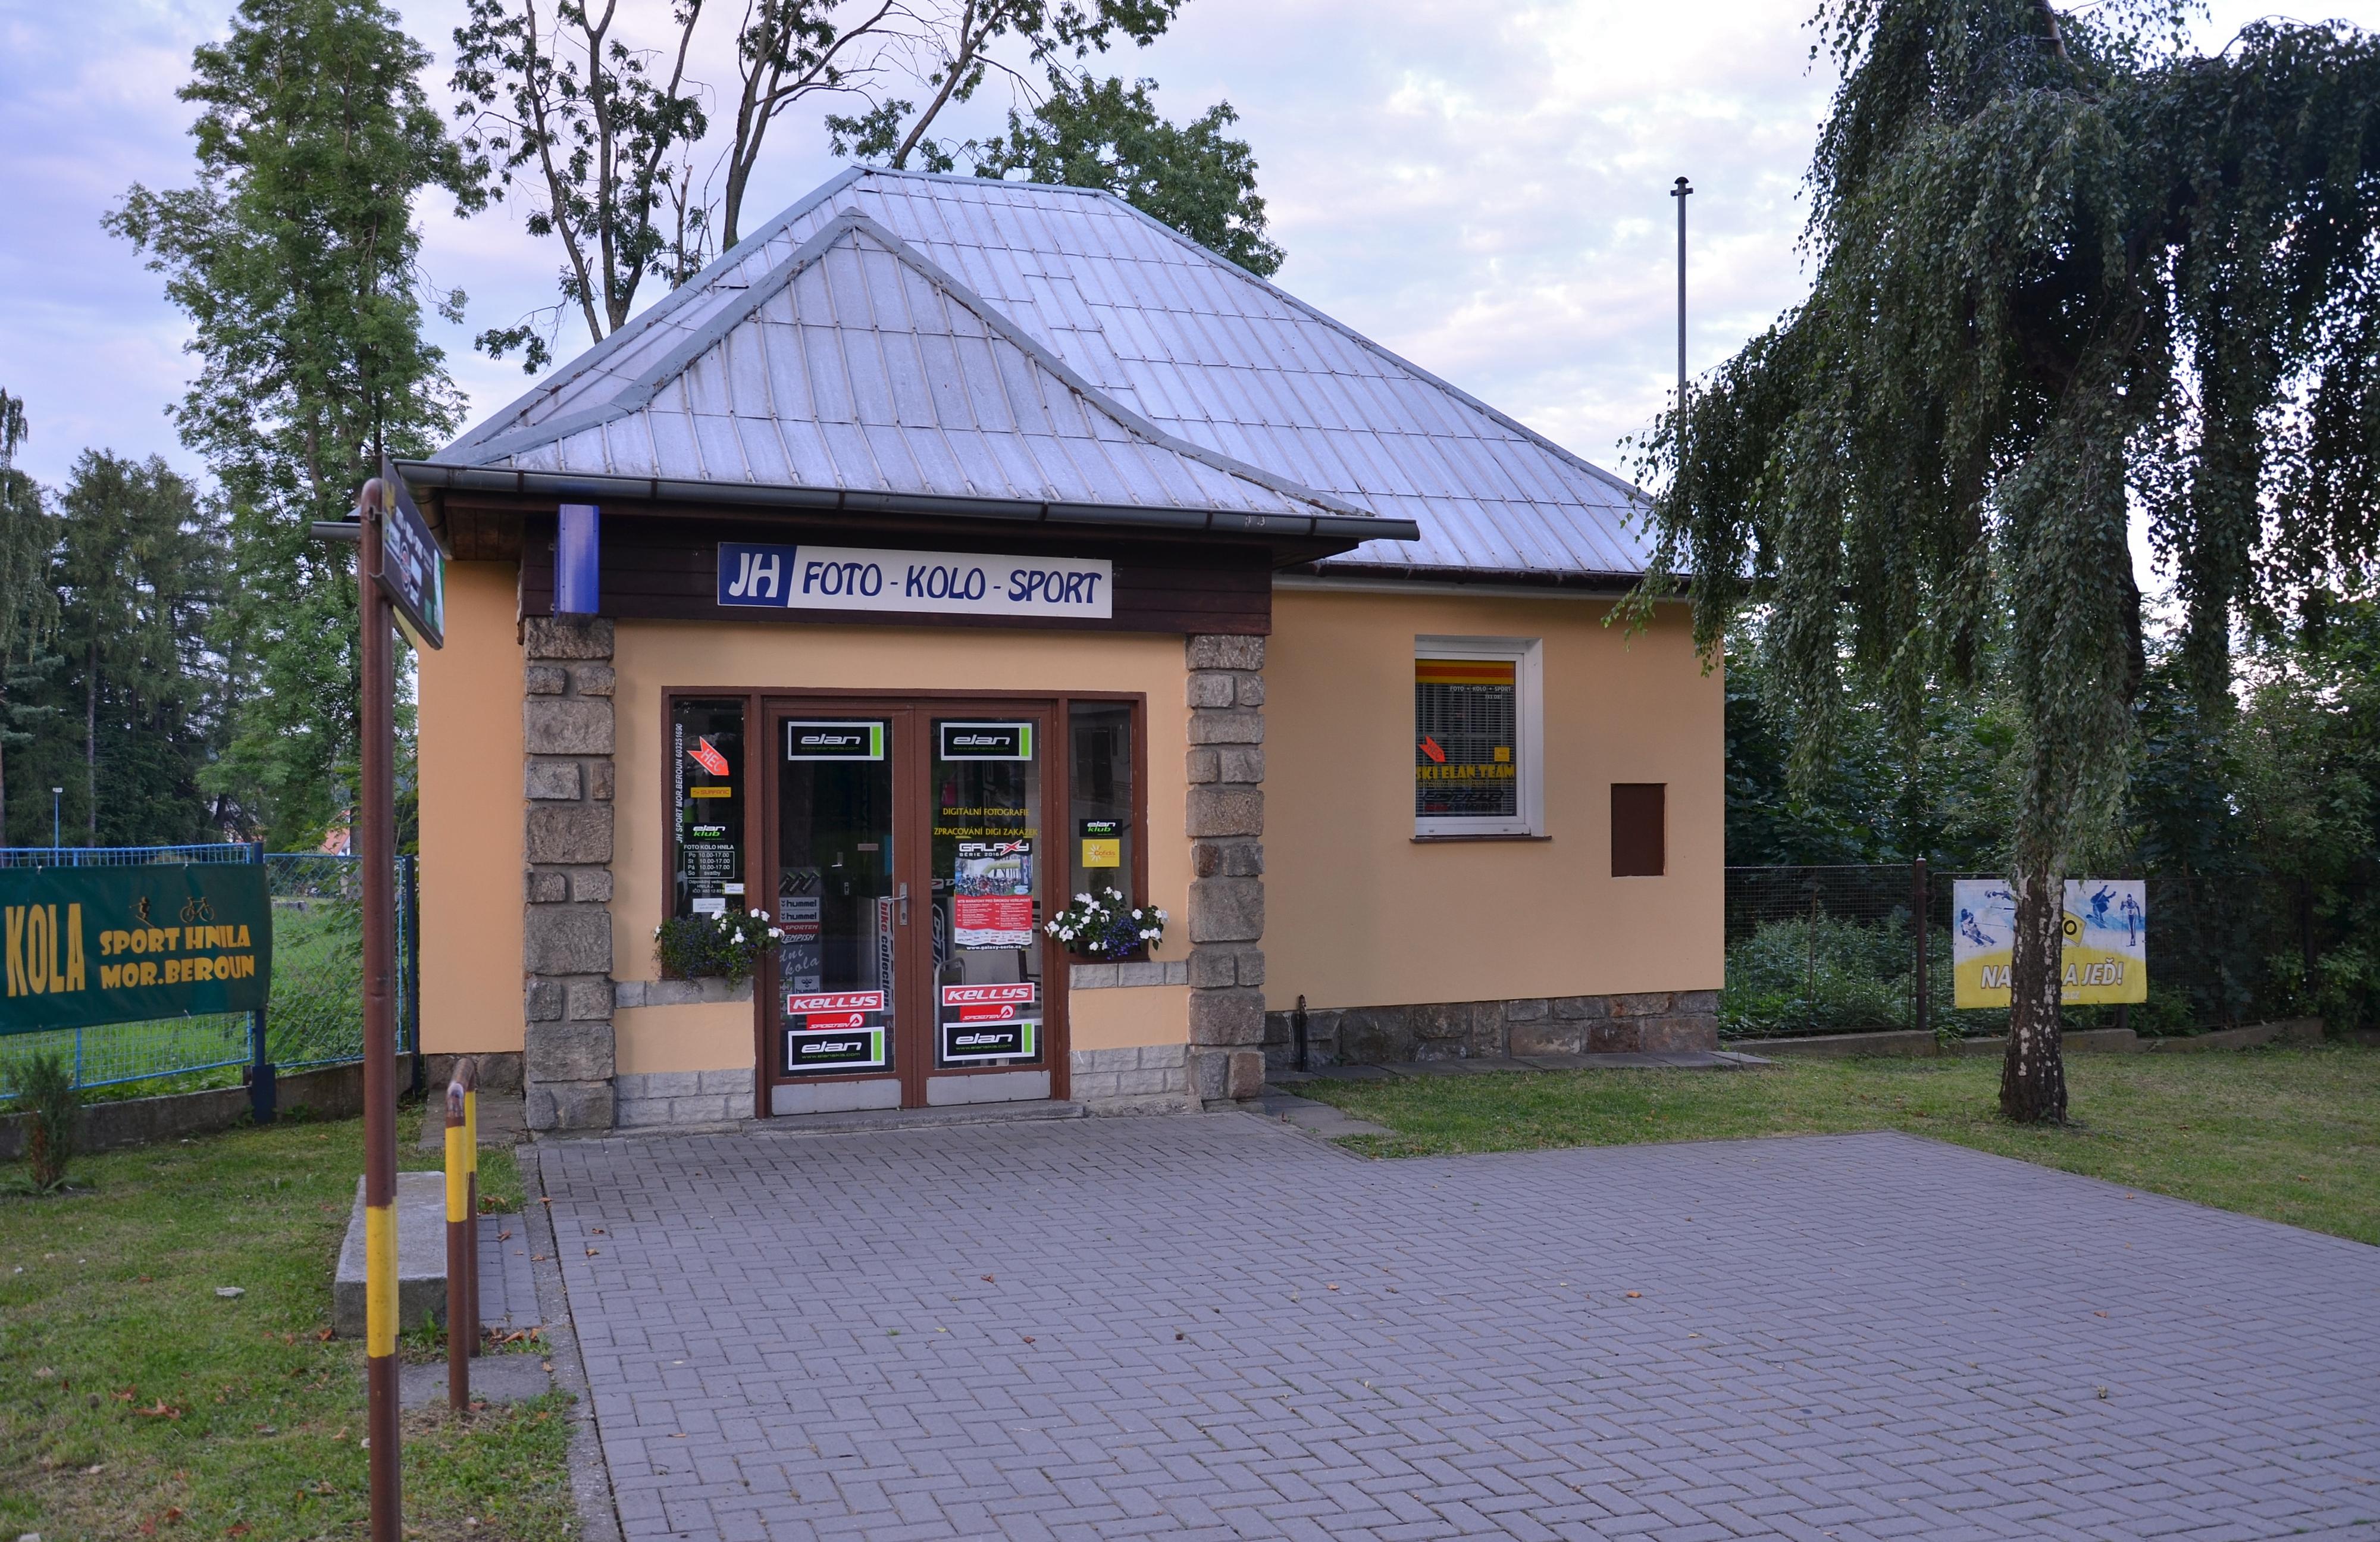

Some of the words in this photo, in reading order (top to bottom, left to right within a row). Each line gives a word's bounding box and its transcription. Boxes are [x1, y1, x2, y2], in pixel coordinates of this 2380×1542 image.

[728, 553, 780, 598] JH
[803, 561, 882, 596] FOTO
[906, 565, 986, 600] KOLO
[1008, 570, 1103, 603] SPORT
[801, 734, 861, 745] elan
[953, 734, 1010, 745] elan
[700, 748, 724, 771] HEC
[1416, 765, 1438, 780] SKI
[1441, 765, 1476, 779] ELAN
[1479, 764, 1515, 778] TEAM
[943, 806, 981, 815] DIGITÁLNÍ
[676, 834, 682, 843] JH
[934, 826, 983, 836] ZPRACOVÁNÍ
[1003, 827, 1038, 836] ZAKÁZEK
[959, 839, 1029, 856] GALAXY
[881, 902, 889, 932] bike
[99, 927, 180, 955] SPORT
[185, 924, 252, 949] HNILA
[5, 903, 86, 997] KOLA
[101, 955, 255, 989] MOR.BEROUN
[785, 958, 819, 975] kola
[2081, 958, 2124, 986] JEĎ!
[801, 1041, 862, 1053] elan
[956, 1033, 1013, 1044] elan
